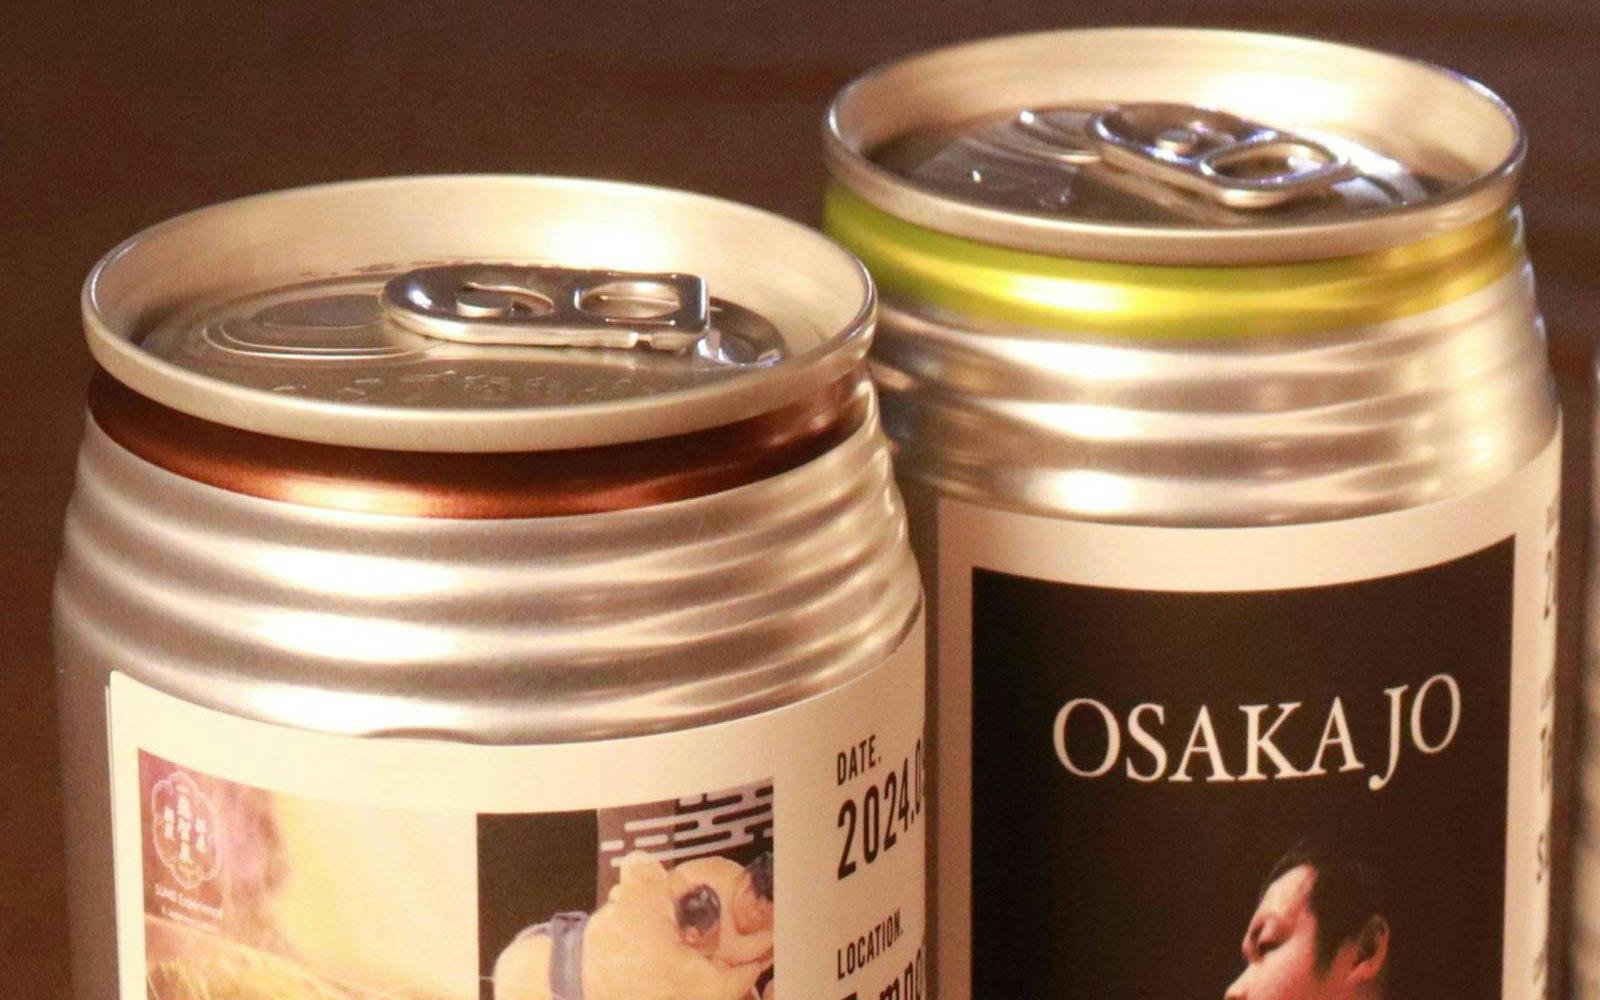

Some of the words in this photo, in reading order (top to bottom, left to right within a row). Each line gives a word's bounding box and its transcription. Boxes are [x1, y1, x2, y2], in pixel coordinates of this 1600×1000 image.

[837, 734, 882, 786] DATE.
[1052, 695, 1366, 784] OSAKA
[1368, 672, 1463, 792] JO
